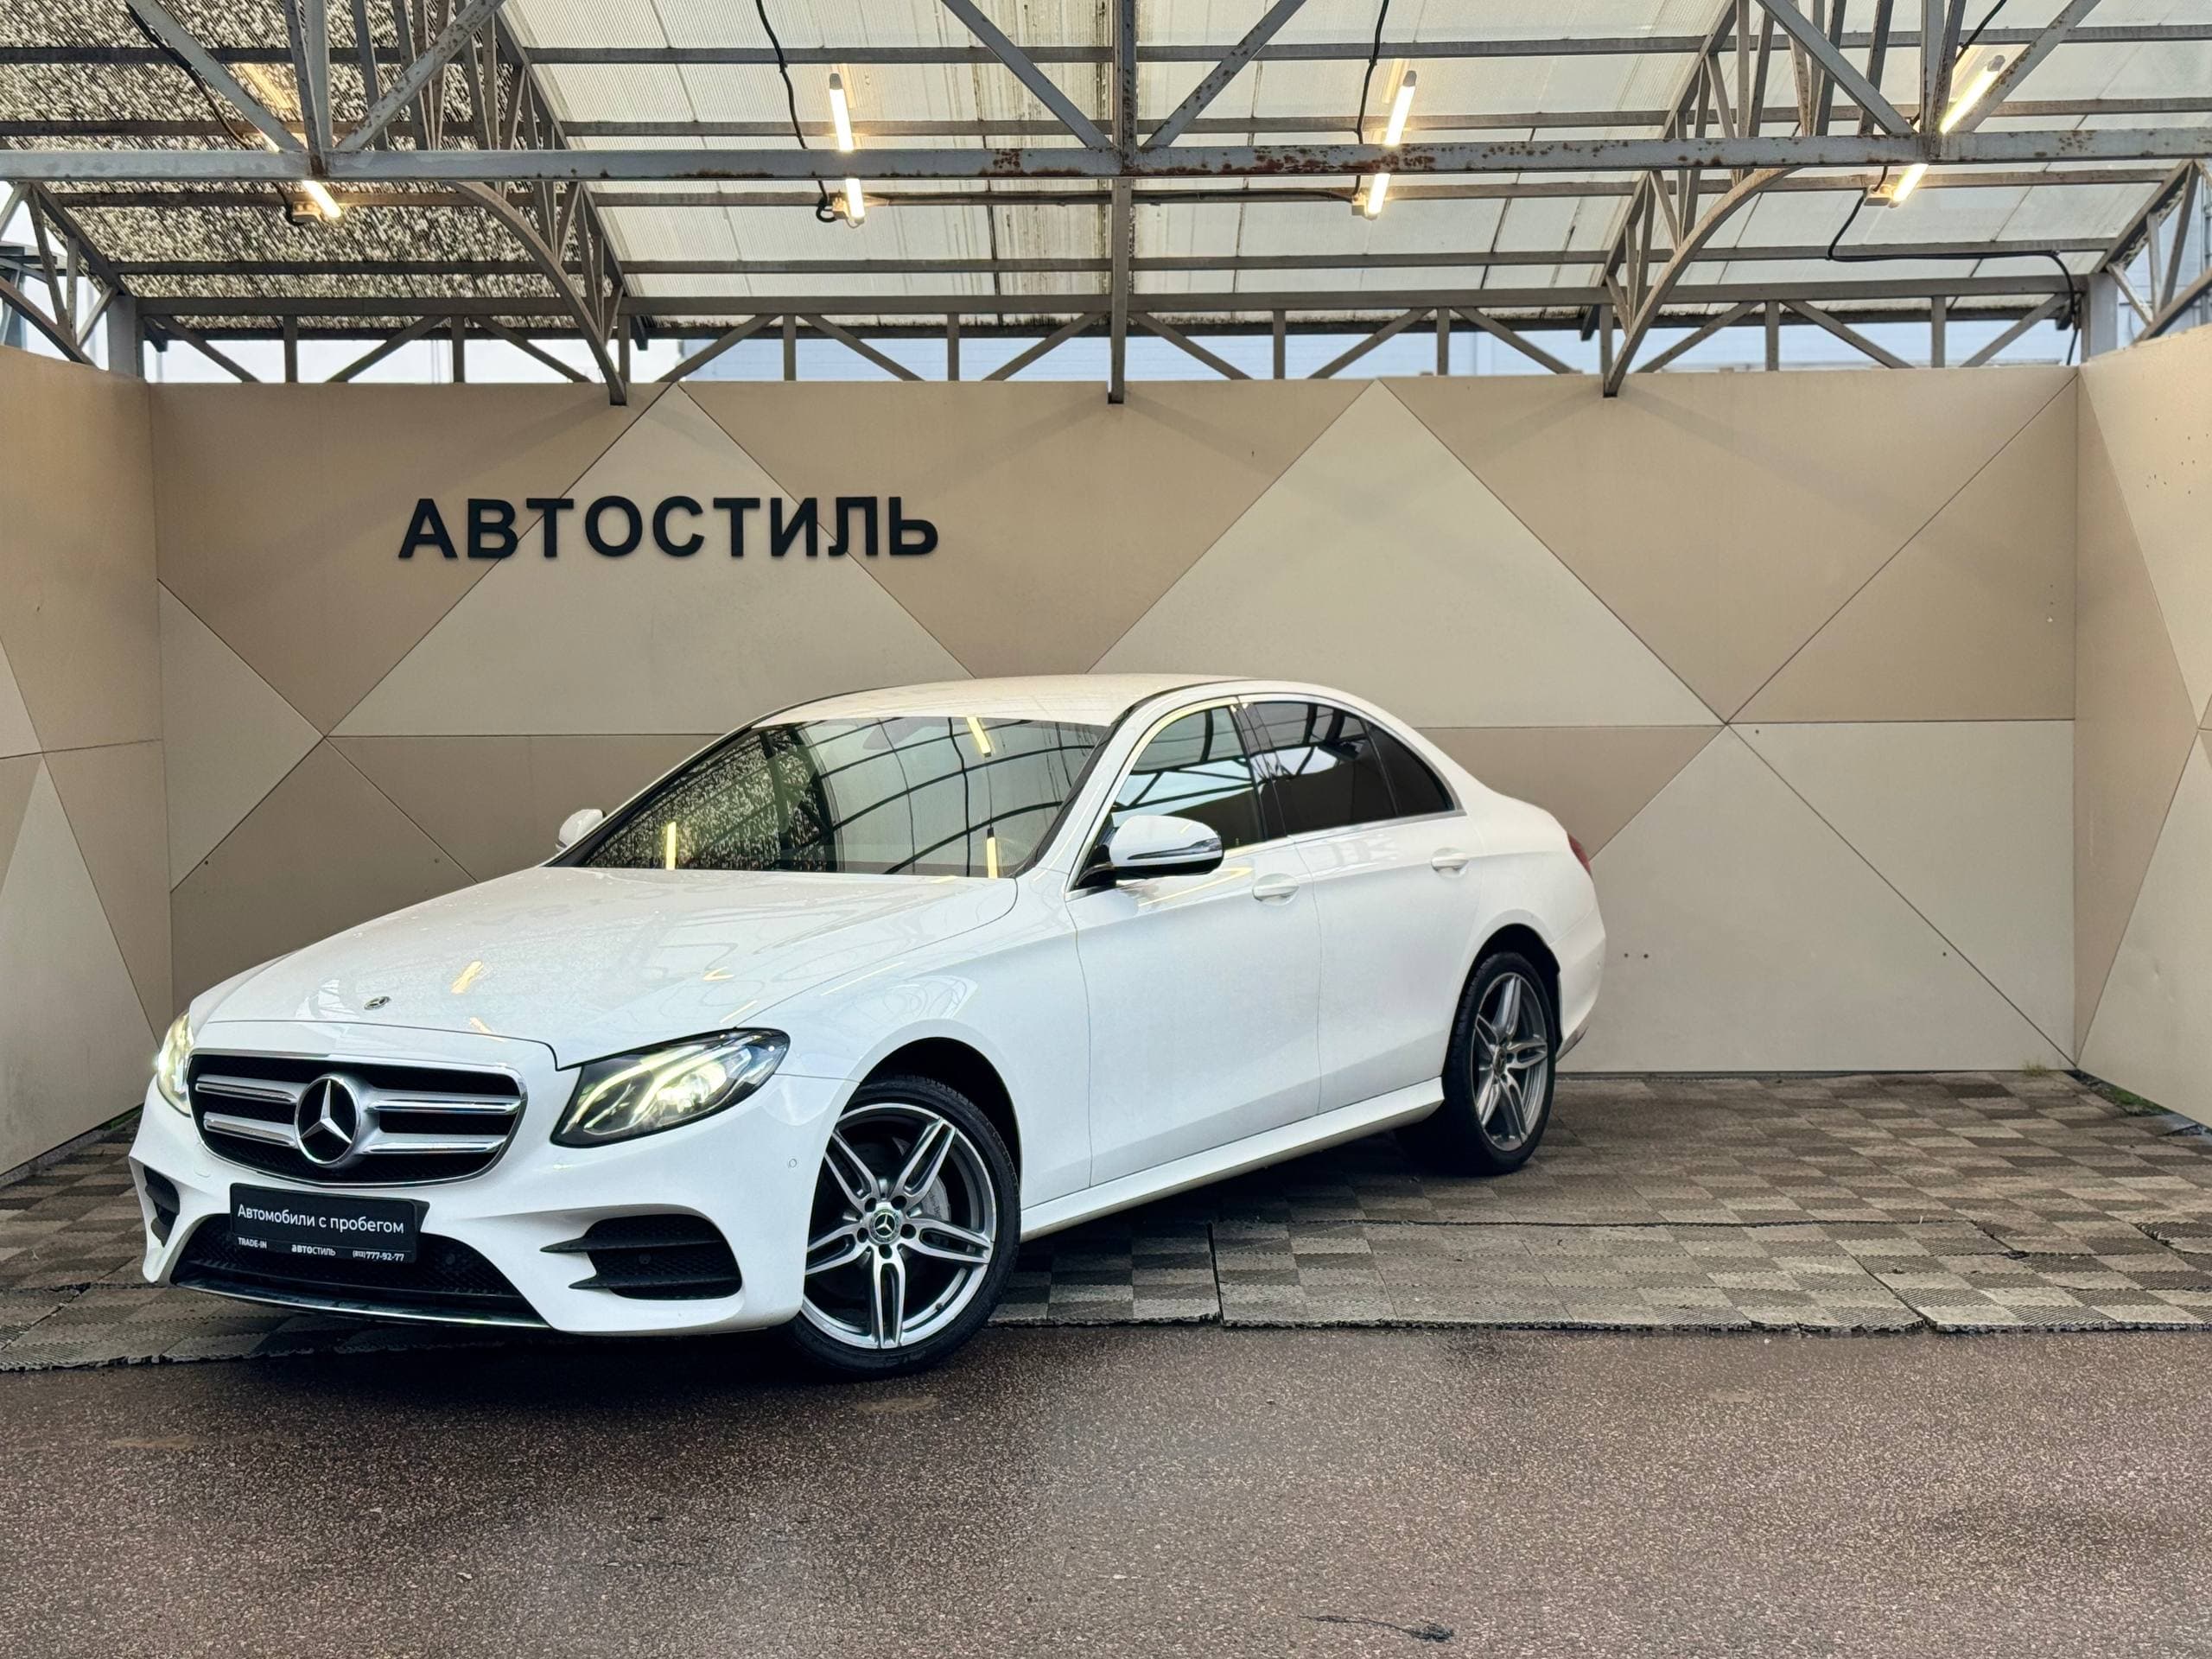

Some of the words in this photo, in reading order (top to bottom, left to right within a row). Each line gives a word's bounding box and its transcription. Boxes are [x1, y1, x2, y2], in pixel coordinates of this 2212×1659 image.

[397, 495, 939, 560] АВТОСТИЛЬ
[238, 1204, 315, 1227] Автомобили
[319, 1217, 327, 1228] с
[331, 1217, 404, 1233] пробегом
[238, 1237, 267, 1249] TRADE-IN
